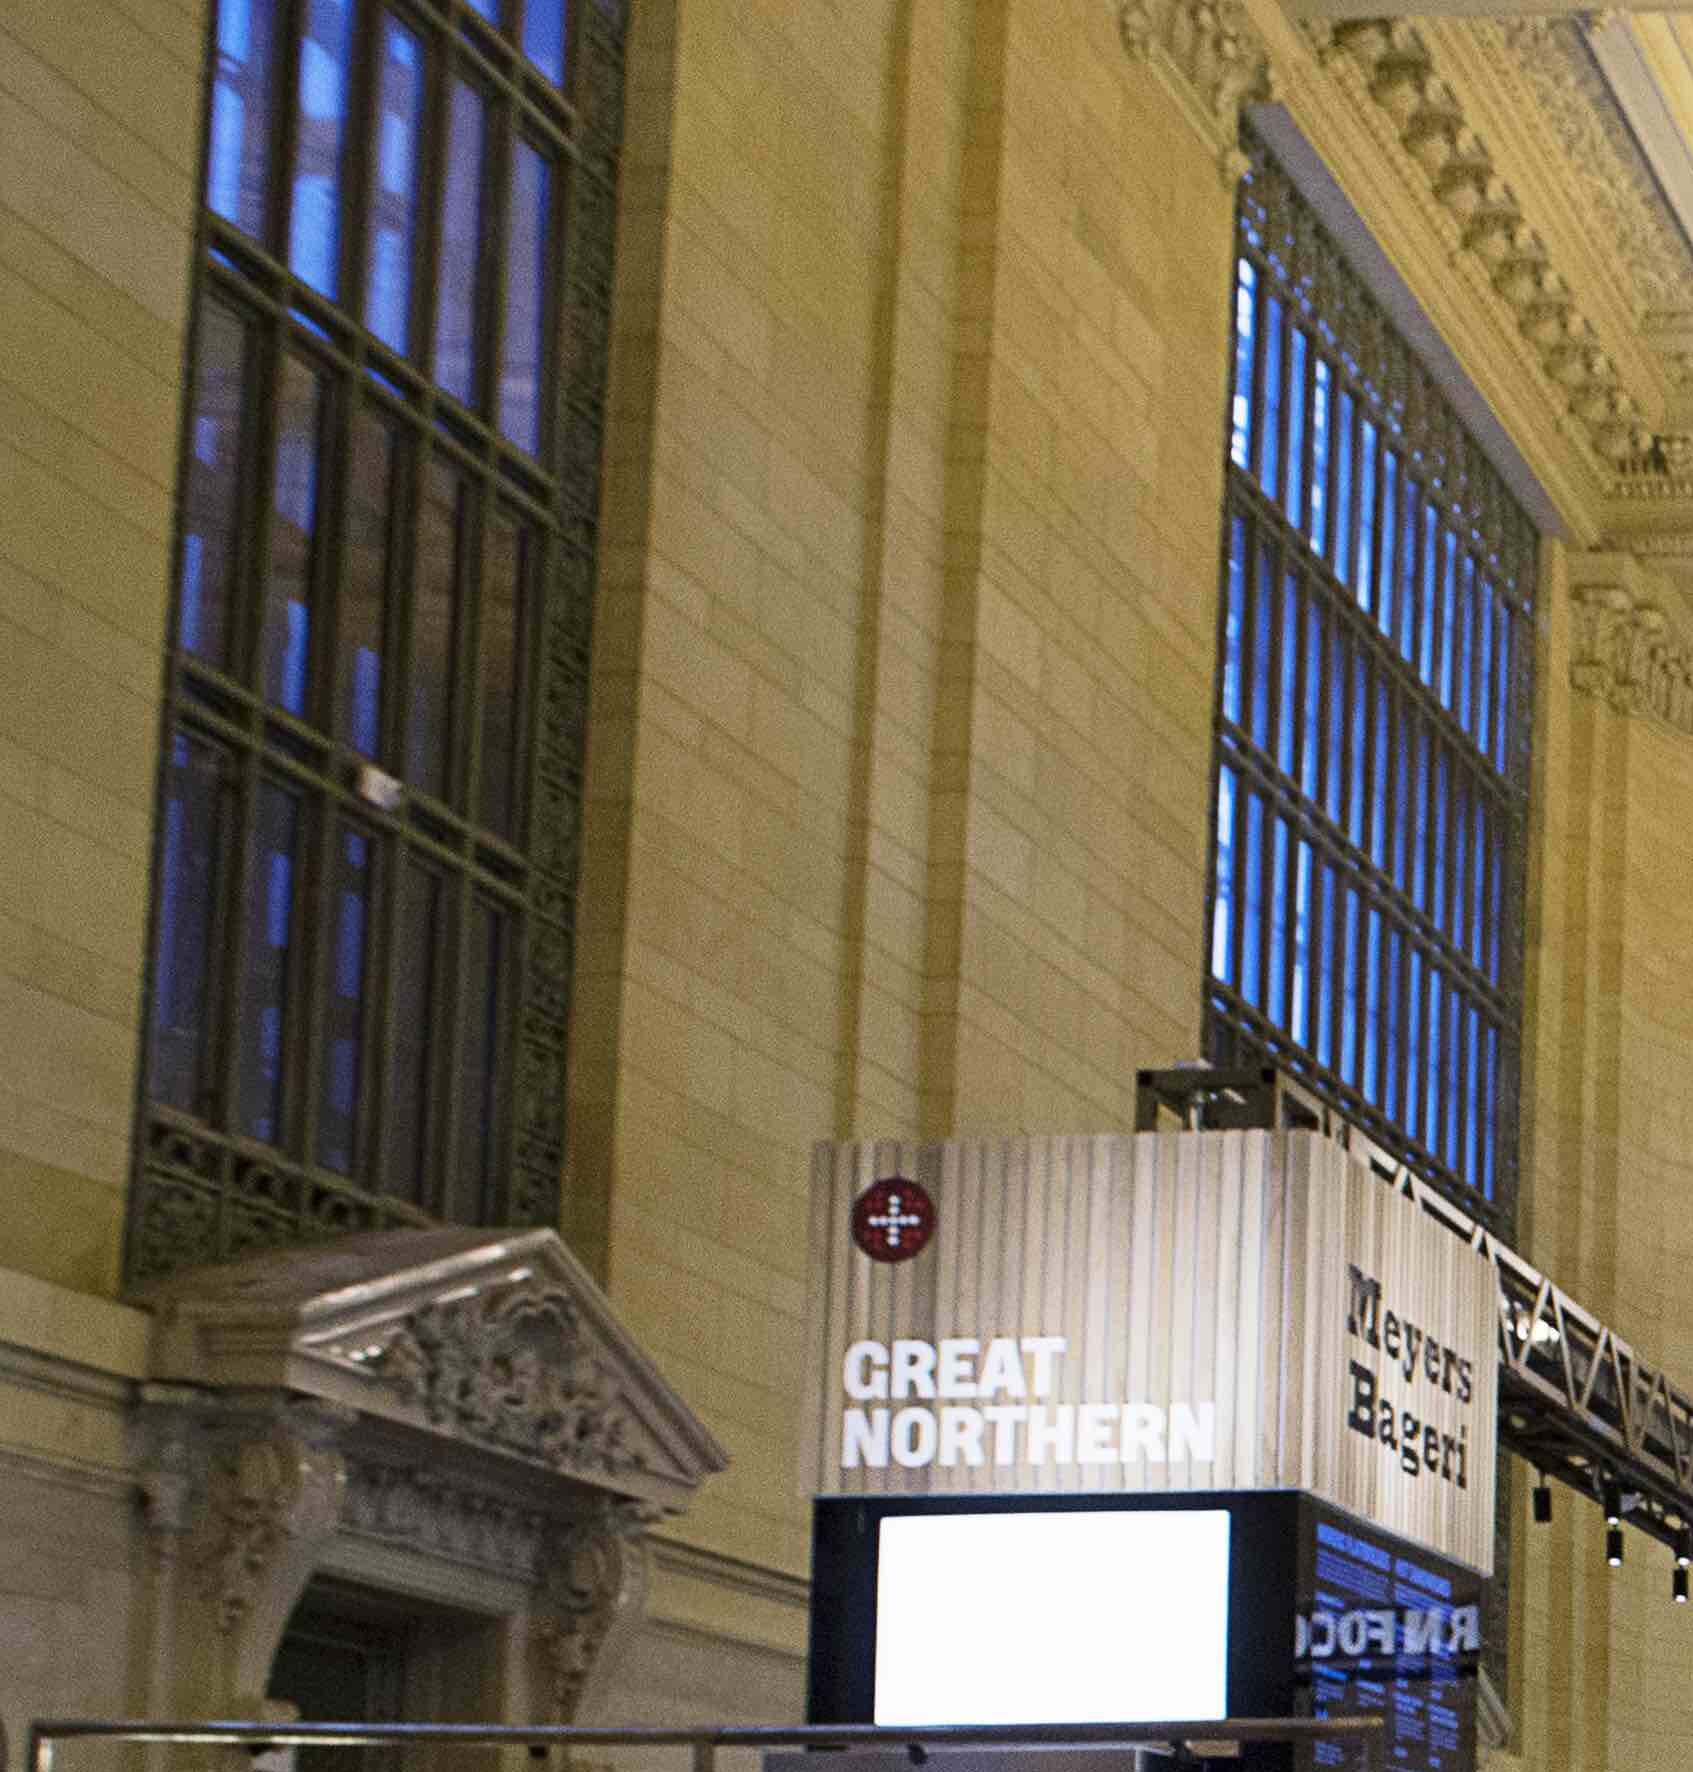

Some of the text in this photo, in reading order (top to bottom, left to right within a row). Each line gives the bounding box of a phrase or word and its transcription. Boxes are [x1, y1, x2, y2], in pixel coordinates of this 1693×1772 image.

[843, 1337, 1066, 1398] GREAT
[1347, 1263, 1472, 1404] Meyers
[841, 1402, 1215, 1467] NORTHERN
[1348, 1360, 1467, 1488] Bageri
